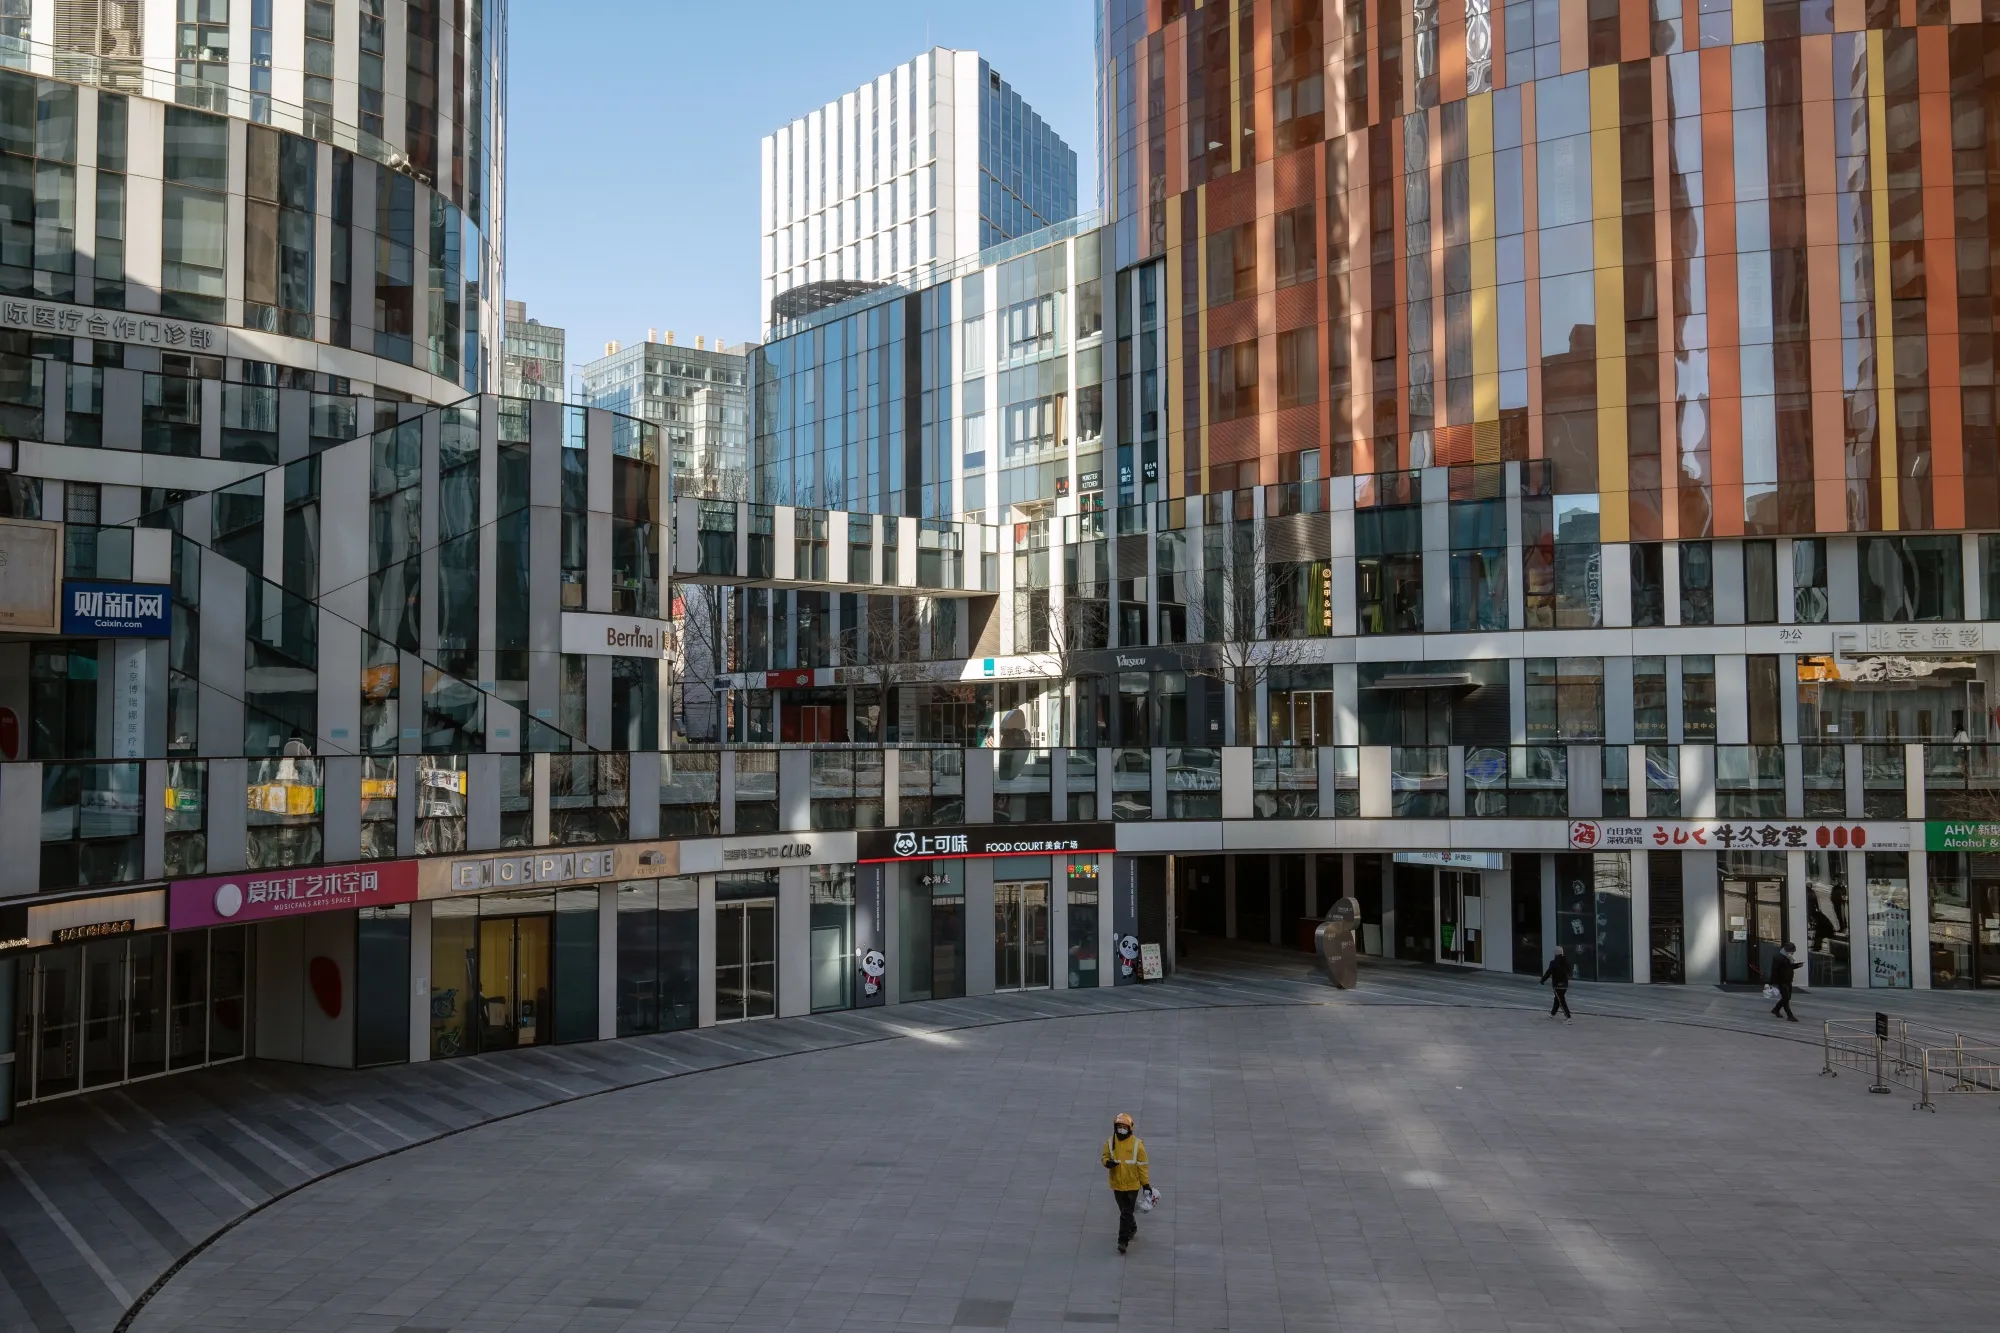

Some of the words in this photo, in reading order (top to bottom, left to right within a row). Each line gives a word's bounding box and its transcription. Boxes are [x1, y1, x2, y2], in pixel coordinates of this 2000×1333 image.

[4, 302, 212, 349] 际医疗合作门诊部
[75, 592, 163, 619] 财新网
[95, 620, 143, 628] Caixin.com
[607, 625, 653, 648] Berrina
[1780, 629, 1803, 640] 办公
[1653, 825, 1707, 845] うしく
[1712, 823, 1807, 848] 牛久食堂
[1945, 824, 1975, 835] AHV
[780, 842, 812, 859] CLUB
[917, 835, 968, 855] 上可味
[986, 842, 1013, 852] FOOD
[1014, 841, 1044, 851] COURT
[1045, 840, 1078, 850] 美食广场
[1944, 838, 1986, 848] Alcohol
[1989, 838, 1999, 847] &
[460, 854, 612, 886] EMOSPACE
[247, 870, 378, 903] 爱乐汇艺术空间
[274, 901, 312, 911] MUSICFANS
[313, 899, 330, 907] ARTS
[331, 896, 351, 905] SPACE
